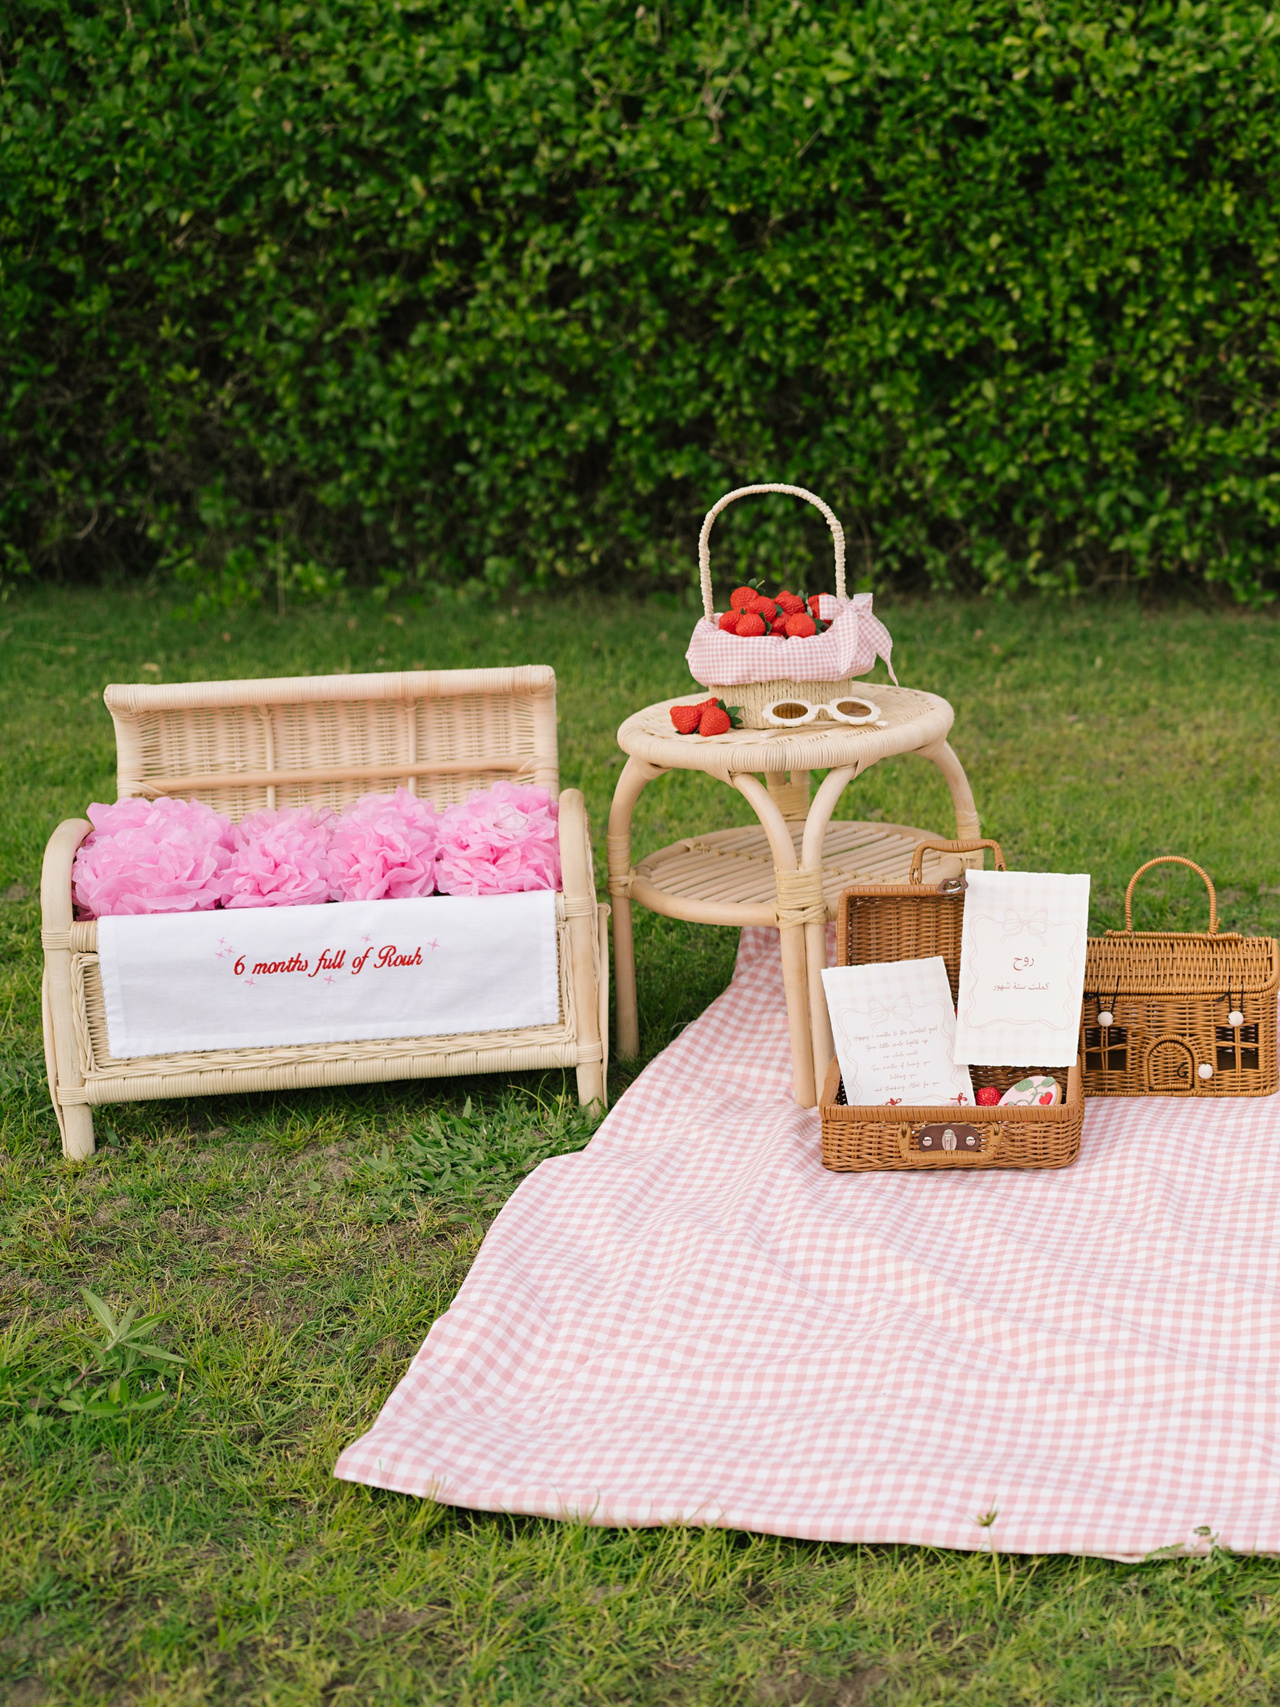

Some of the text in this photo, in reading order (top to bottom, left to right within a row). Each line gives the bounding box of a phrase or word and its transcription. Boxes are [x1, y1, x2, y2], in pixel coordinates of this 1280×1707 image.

[233, 944, 423, 978] 6 months full of Rouh
[1012, 956, 1035, 971] روح
